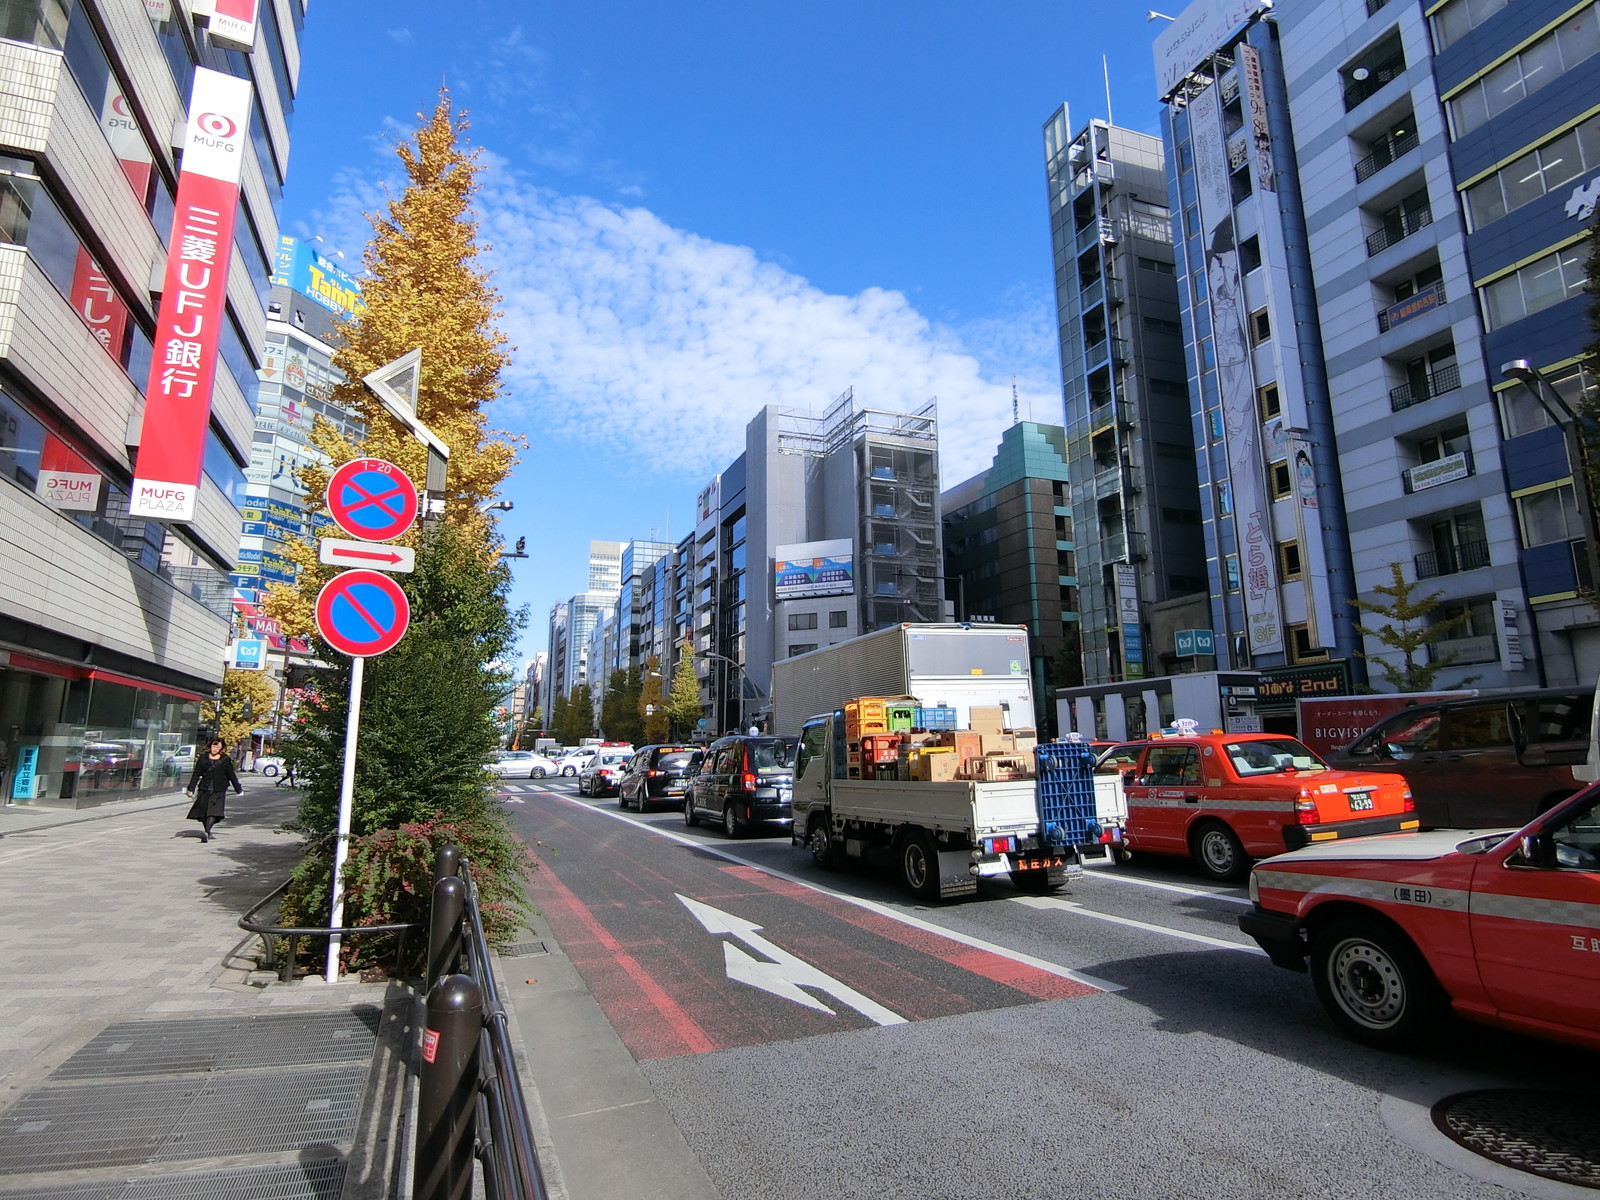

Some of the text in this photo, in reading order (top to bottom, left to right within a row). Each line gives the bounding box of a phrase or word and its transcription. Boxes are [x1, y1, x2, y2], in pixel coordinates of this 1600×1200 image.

[218, 17, 247, 33] MUFG
[193, 135, 234, 153] MUFG
[161, 206, 220, 398] 三菱UFJ銀行
[306, 286, 345, 313] HOBBY
[361, 461, 392, 474] 7-20
[141, 487, 185, 501] MUFG
[139, 497, 185, 513] PLAZA
[244, 498, 268, 508] odel
[1254, 624, 1276, 643] 8F
[1300, 676, 1338, 693] 2nd
